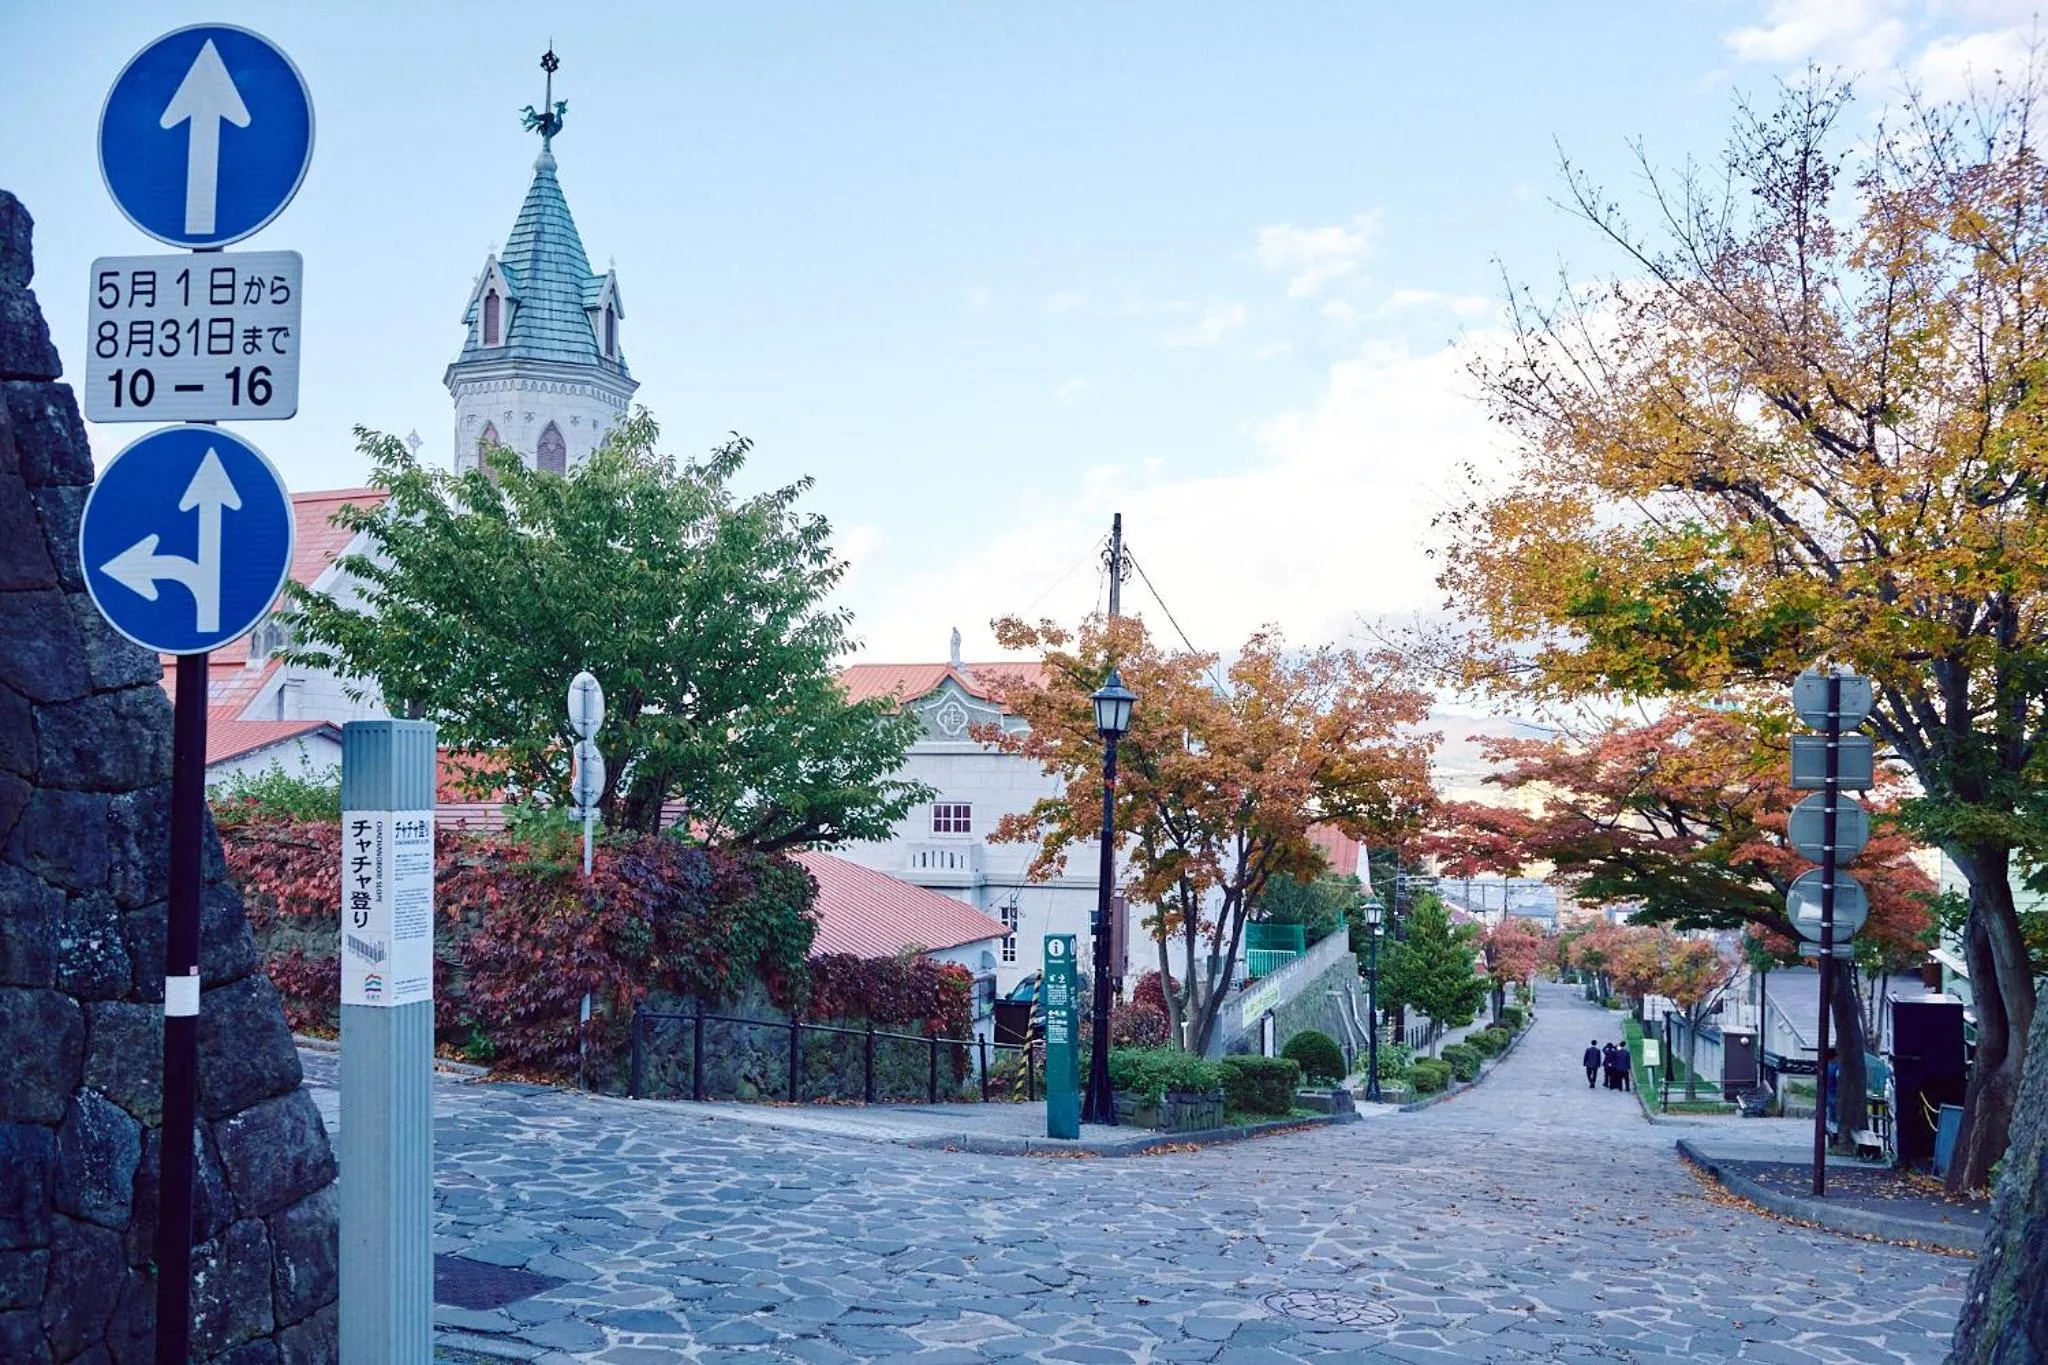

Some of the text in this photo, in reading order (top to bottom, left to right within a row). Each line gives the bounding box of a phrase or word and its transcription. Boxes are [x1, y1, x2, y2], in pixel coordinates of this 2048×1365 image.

[98, 267, 291, 310] 5月1日から
[96, 317, 290, 359] 8月31日まで
[108, 368, 155, 408] 10
[225, 365, 273, 407] 16
[351, 819, 372, 929] チャチャ登り
